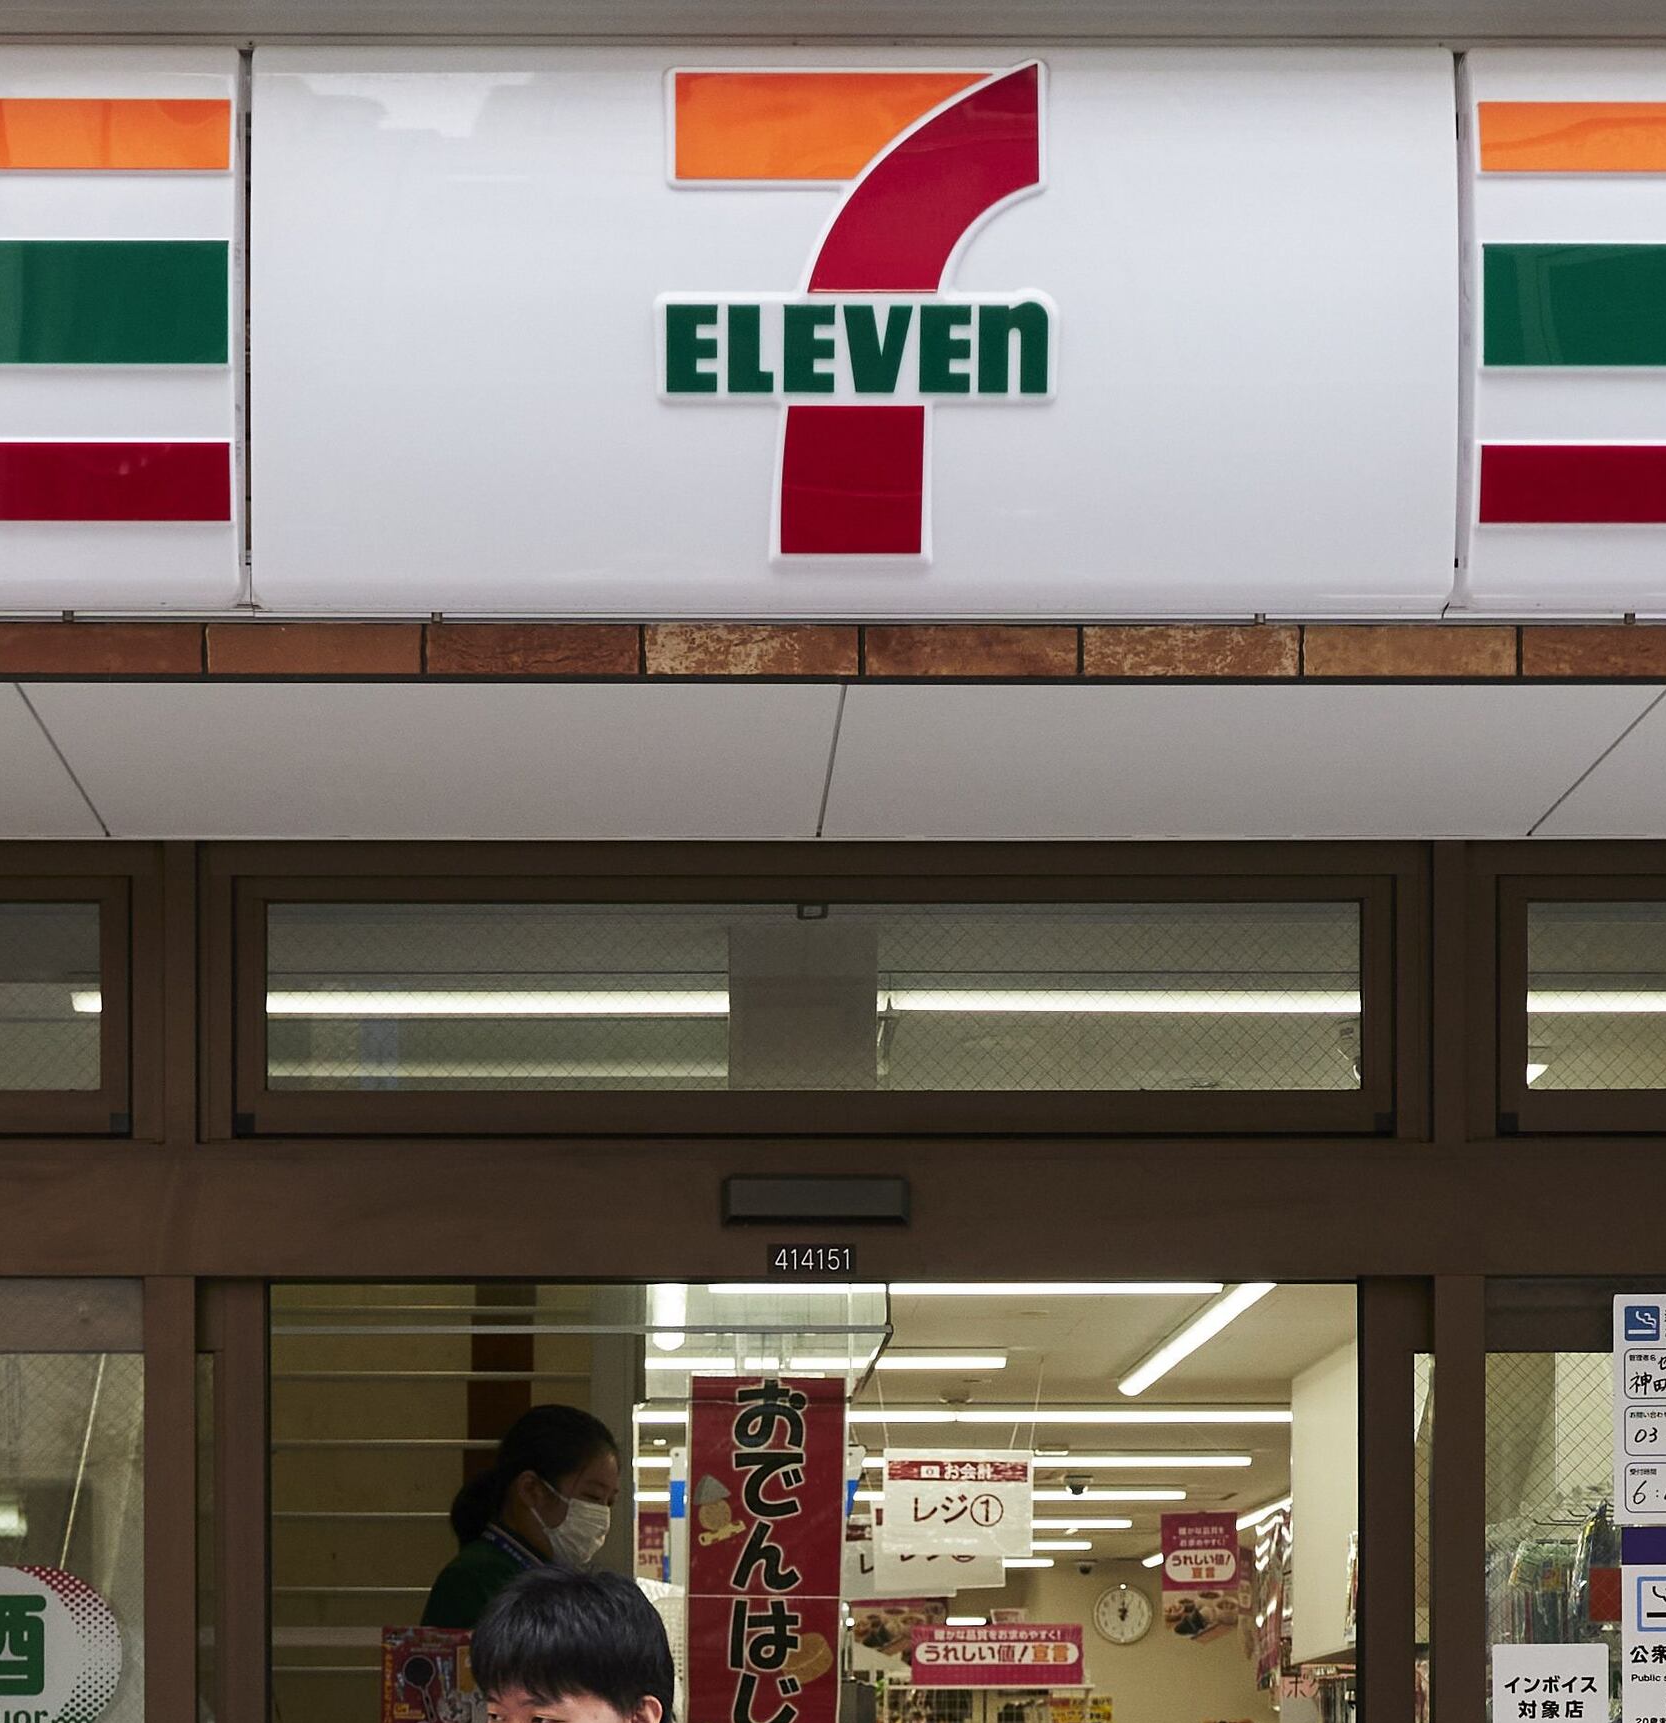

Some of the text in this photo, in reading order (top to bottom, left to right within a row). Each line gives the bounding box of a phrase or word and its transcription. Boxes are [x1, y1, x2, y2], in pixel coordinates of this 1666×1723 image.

[673, 62, 1040, 554] 7
[774, 1247, 852, 1271] 414151
[944, 1464, 994, 1479] お会計
[1504, 1676, 1598, 1693] インボイス
[1631, 1674, 1661, 1682] Public
[1518, 1700, 1584, 1719] 対象店
